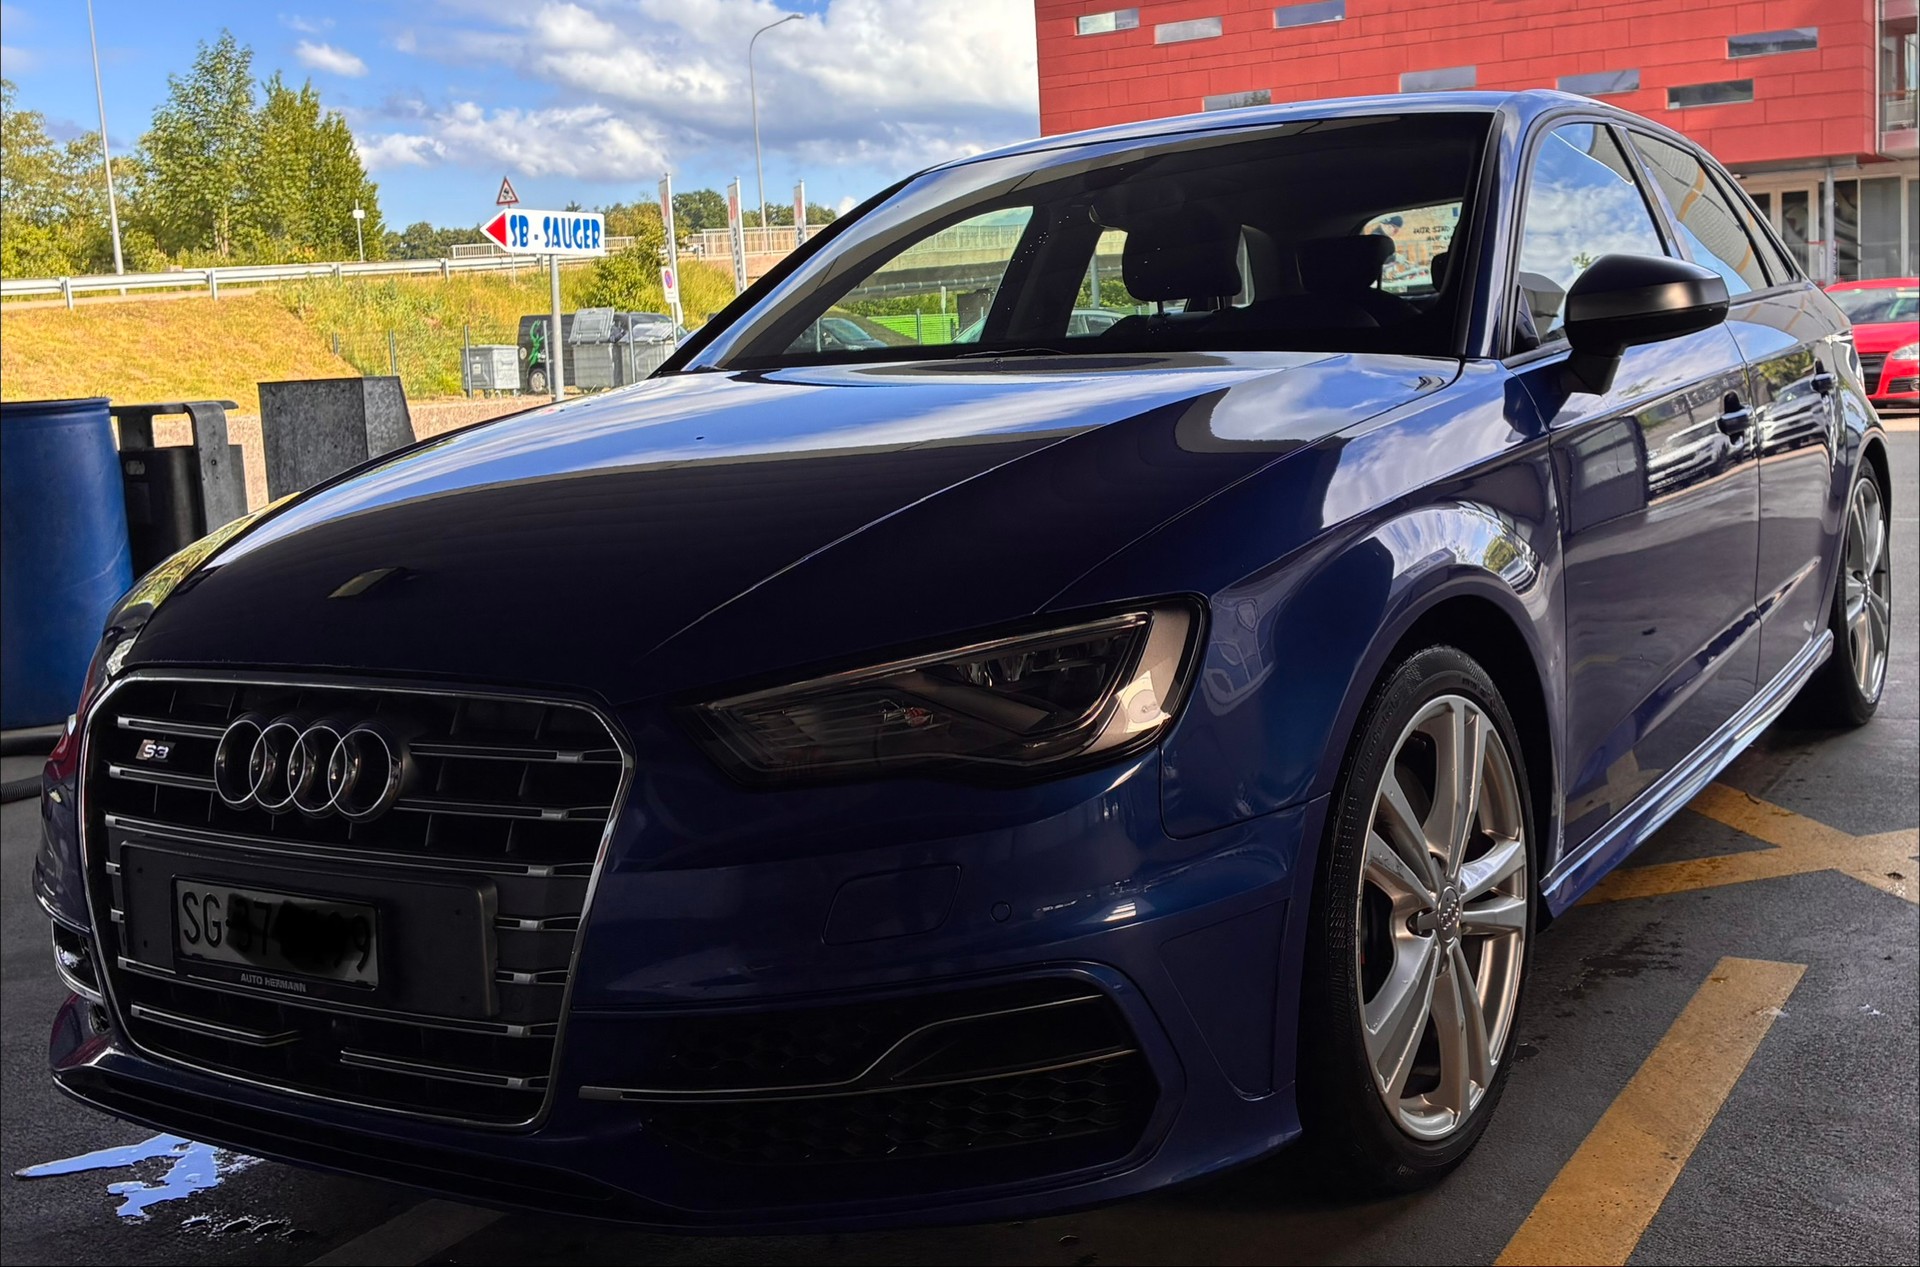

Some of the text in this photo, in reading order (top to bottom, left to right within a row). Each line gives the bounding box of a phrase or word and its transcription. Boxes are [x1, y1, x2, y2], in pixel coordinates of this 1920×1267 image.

[509, 214, 529, 248] SB
[543, 216, 601, 249] SAUGER
[142, 744, 169, 759] S3
[182, 891, 222, 948] SG
[241, 973, 306, 992] AUTO HERMANN
